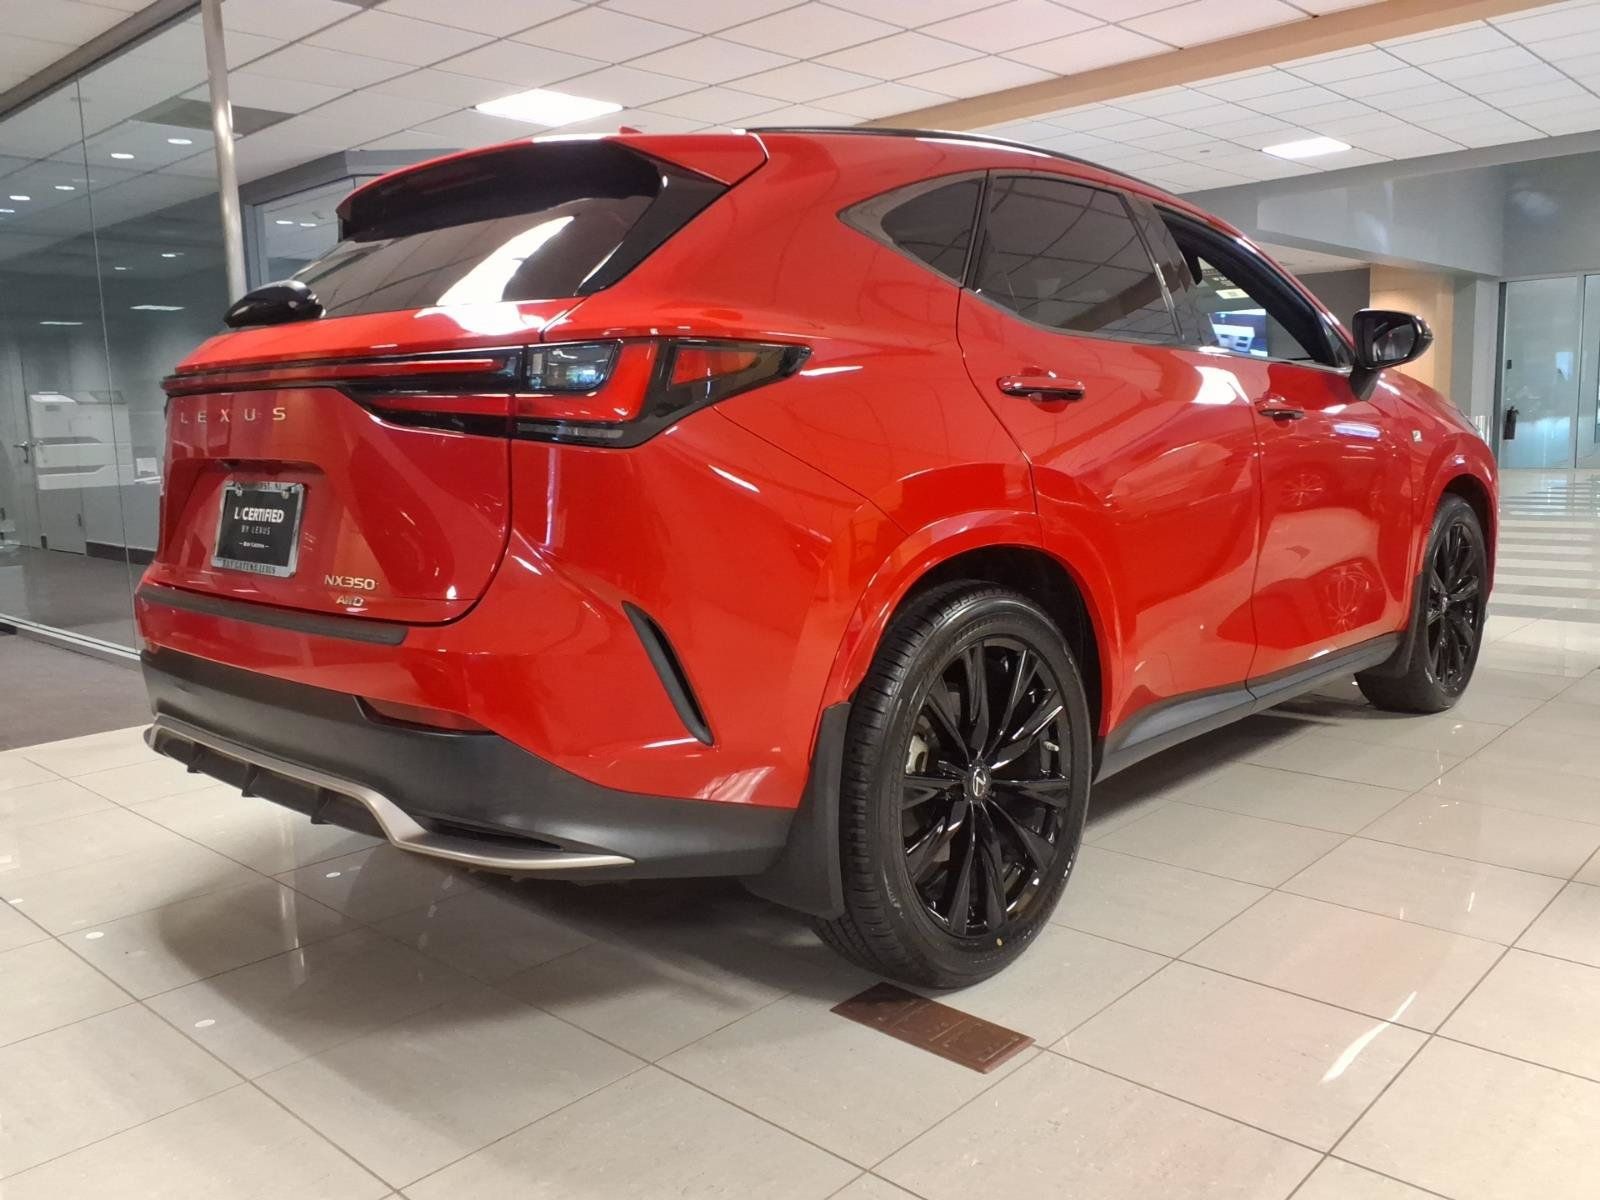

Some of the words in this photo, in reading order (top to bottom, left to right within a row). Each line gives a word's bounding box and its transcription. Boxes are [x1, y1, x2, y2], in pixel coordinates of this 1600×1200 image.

[180, 406, 286, 424] LEXUS
[251, 525, 272, 536] LEXUS
[324, 574, 375, 591] NX350
